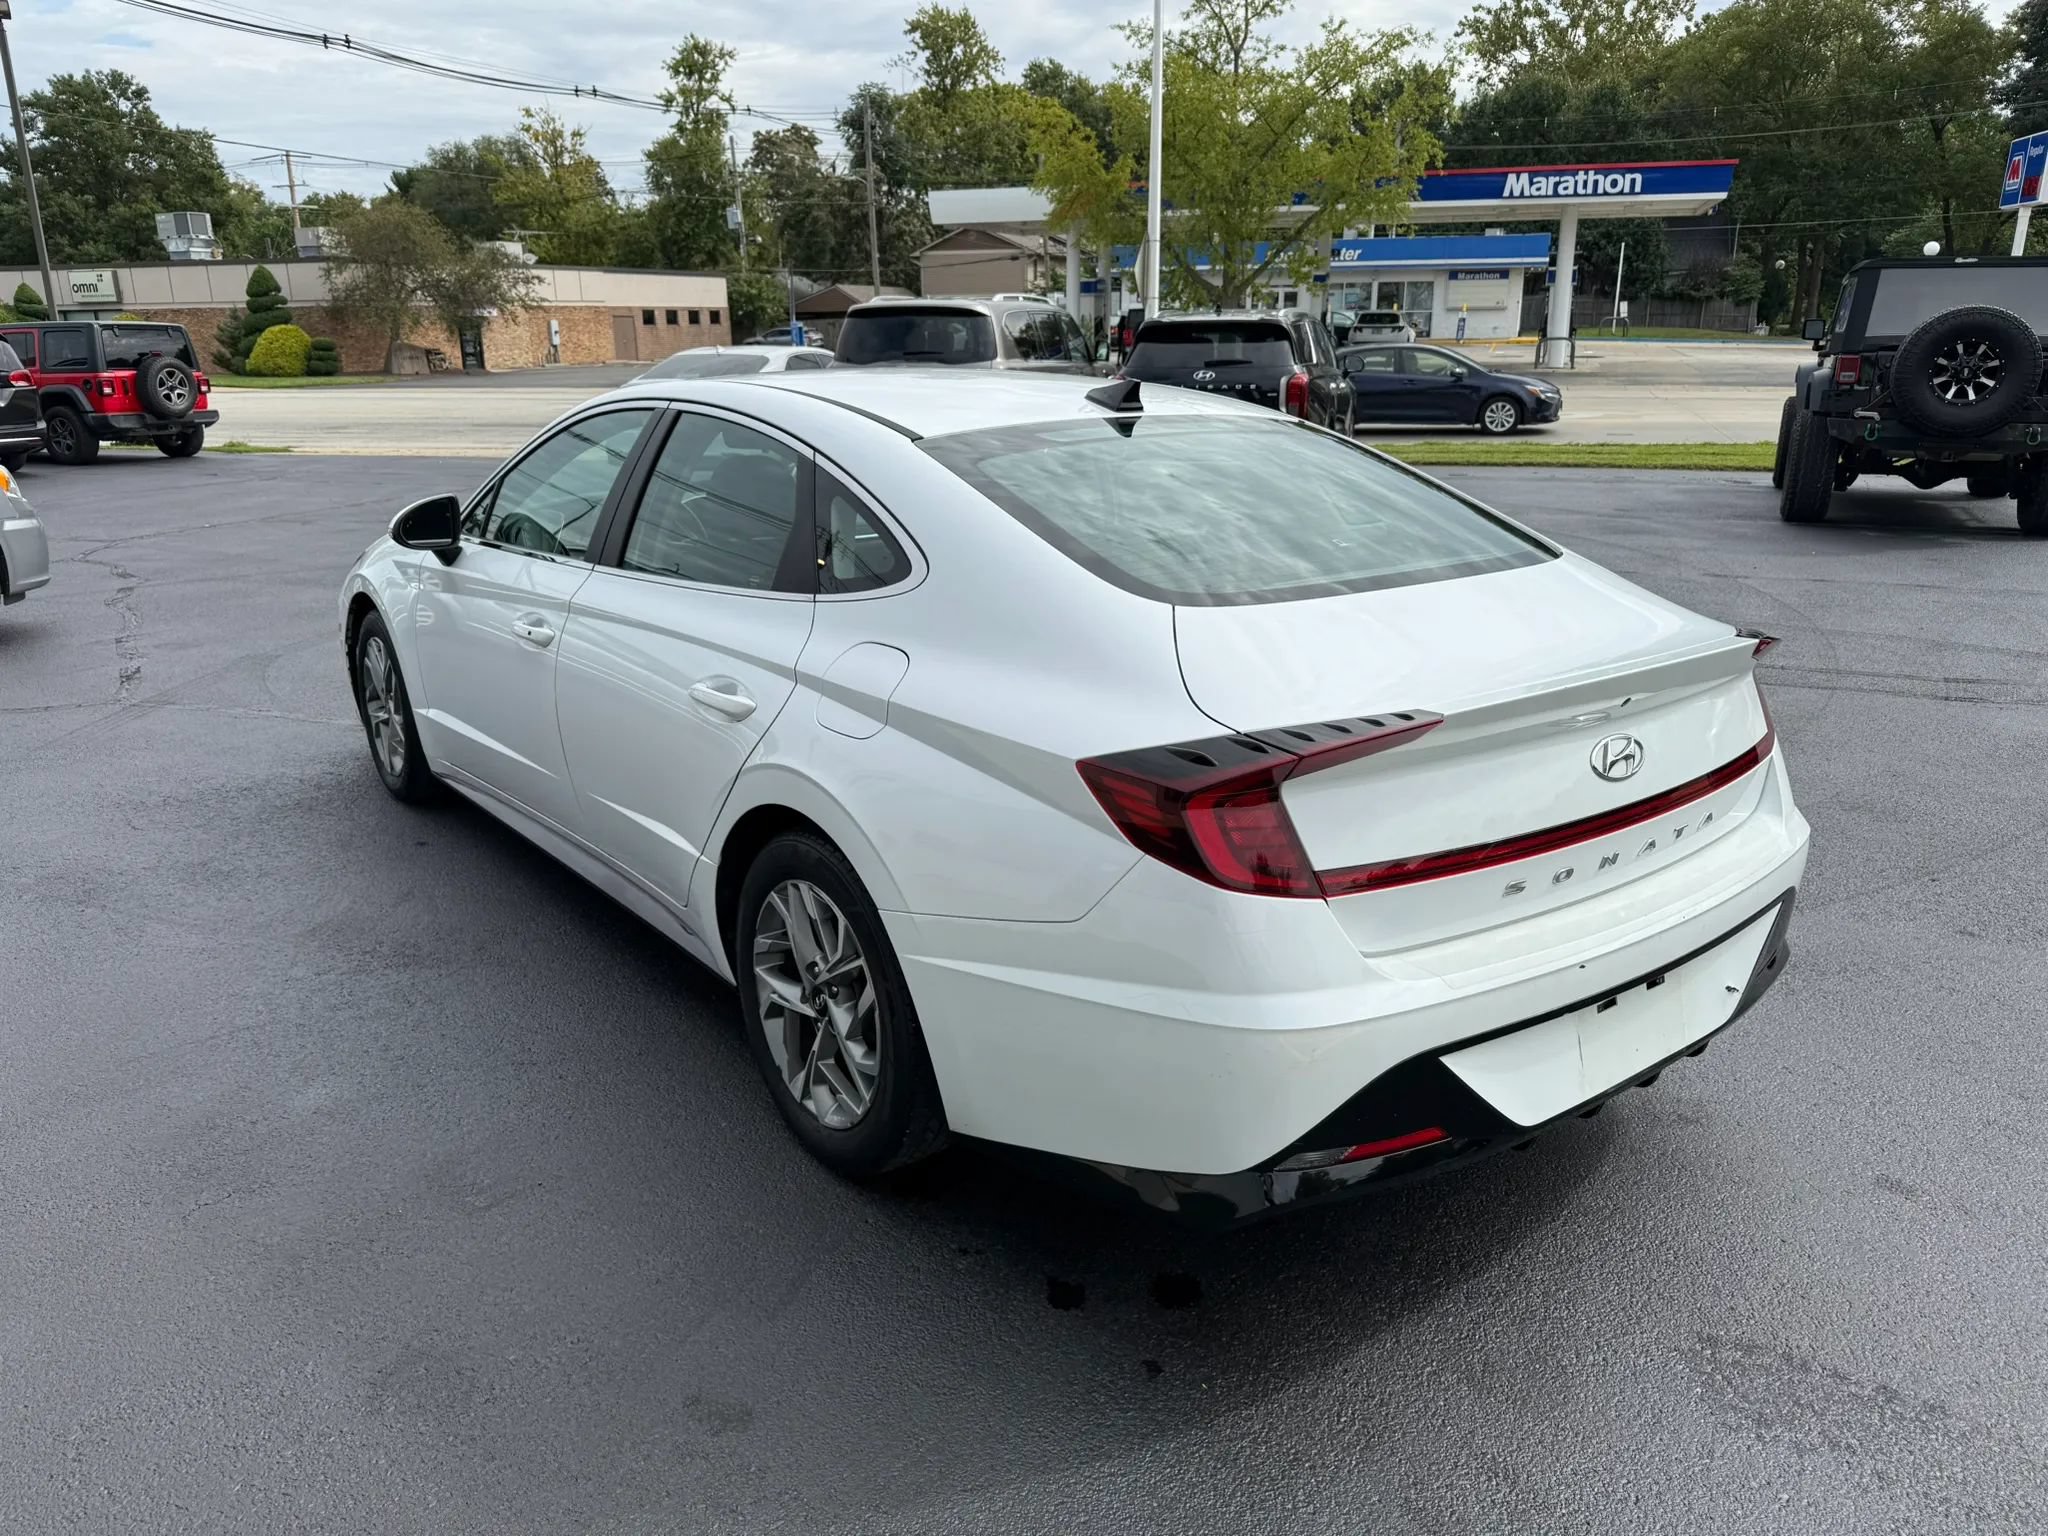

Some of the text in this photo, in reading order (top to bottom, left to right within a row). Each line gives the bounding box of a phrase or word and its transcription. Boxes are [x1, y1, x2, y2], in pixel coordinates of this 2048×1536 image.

[1502, 170, 1642, 197] Marathon
[1330, 247, 1362, 261] ter
[1457, 271, 1500, 280] Marathon
[72, 283, 98, 293] omni
[1502, 811, 1713, 898] SONATA
